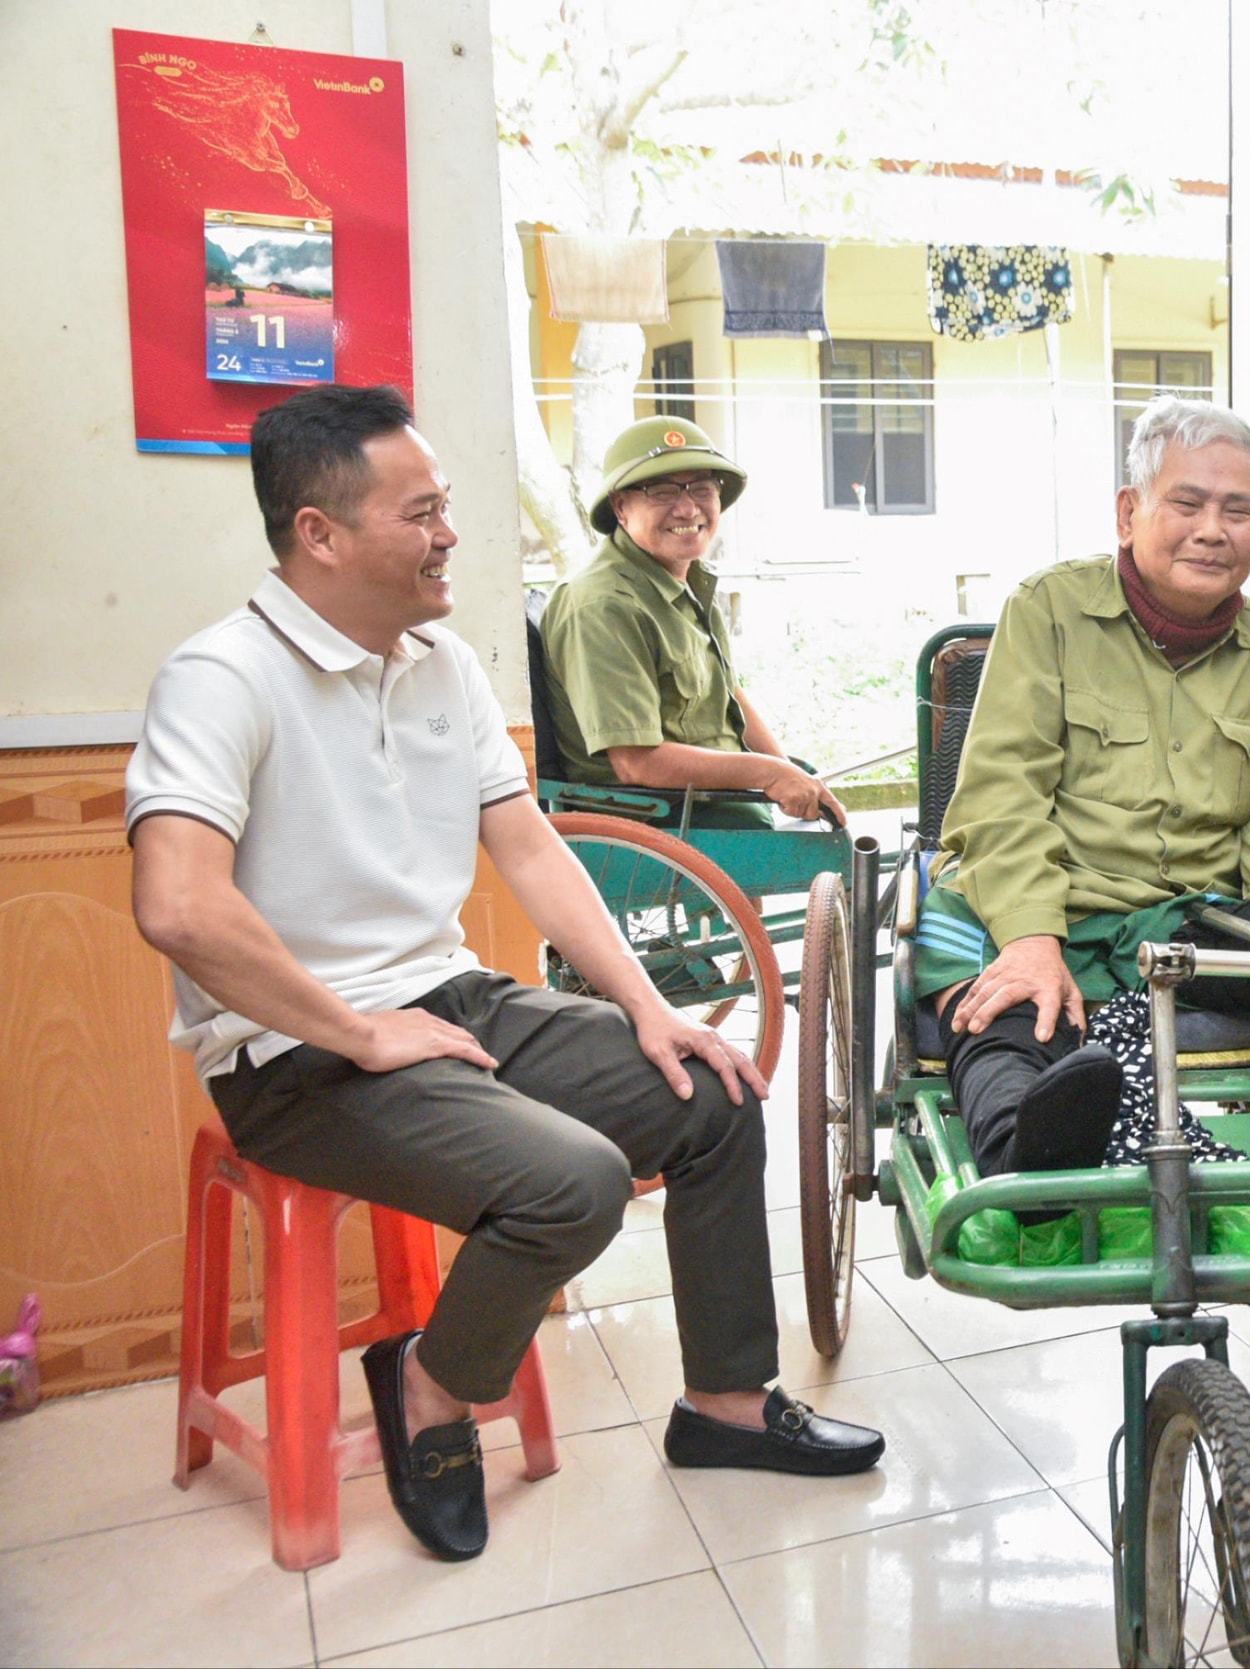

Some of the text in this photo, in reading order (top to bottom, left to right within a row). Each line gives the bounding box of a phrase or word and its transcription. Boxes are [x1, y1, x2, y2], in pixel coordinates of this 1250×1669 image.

[313, 78, 371, 95] VietinBank
[250, 314, 286, 349] 11
[216, 354, 242, 371] 24
